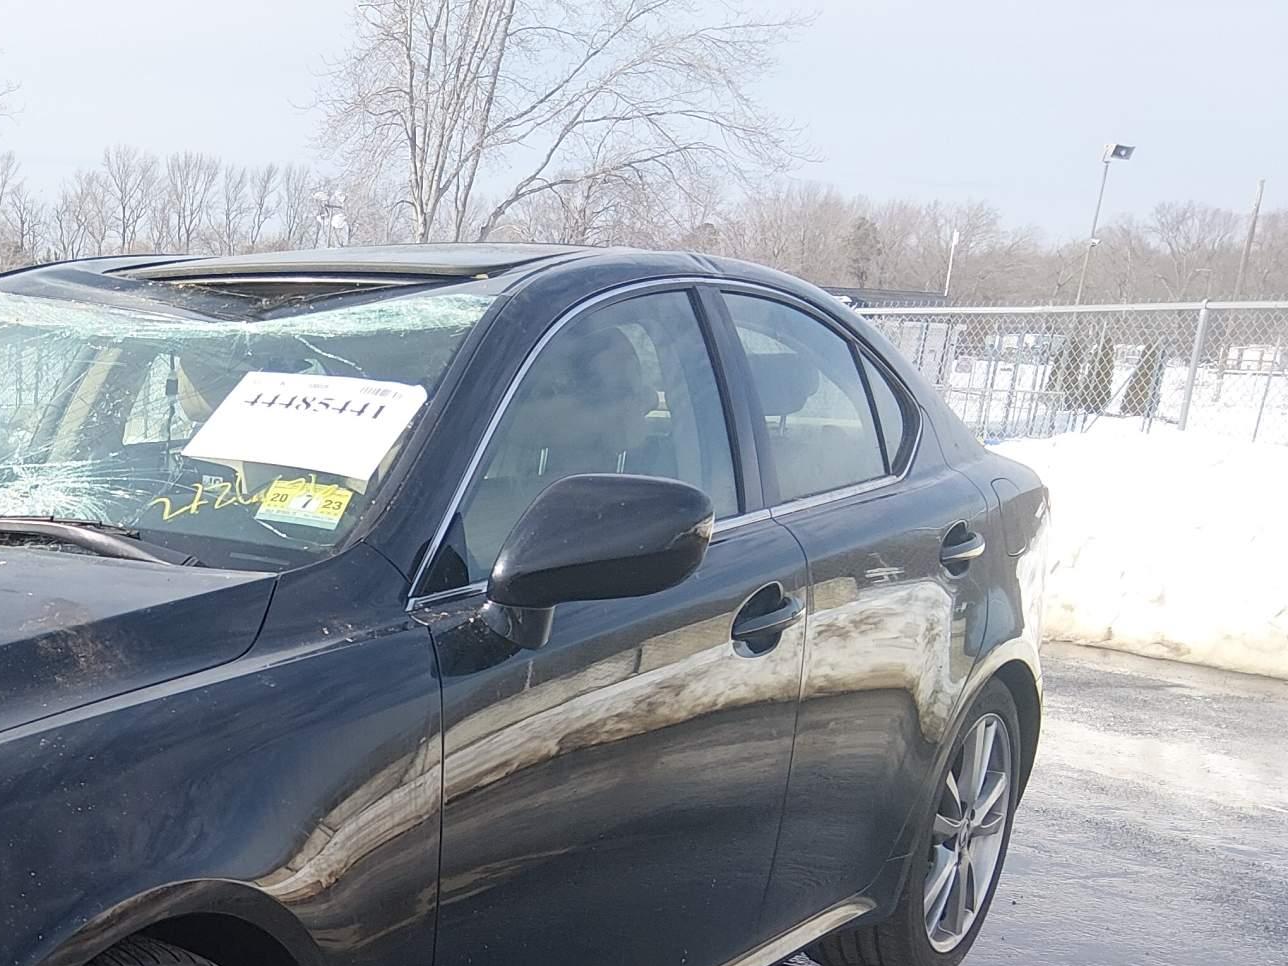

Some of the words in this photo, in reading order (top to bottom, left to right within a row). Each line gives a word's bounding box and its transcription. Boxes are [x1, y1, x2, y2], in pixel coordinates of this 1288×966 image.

[244, 392, 386, 419] 44485441
[270, 492, 289, 503] 20
[302, 494, 313, 509] 7
[322, 499, 343, 511] 23
